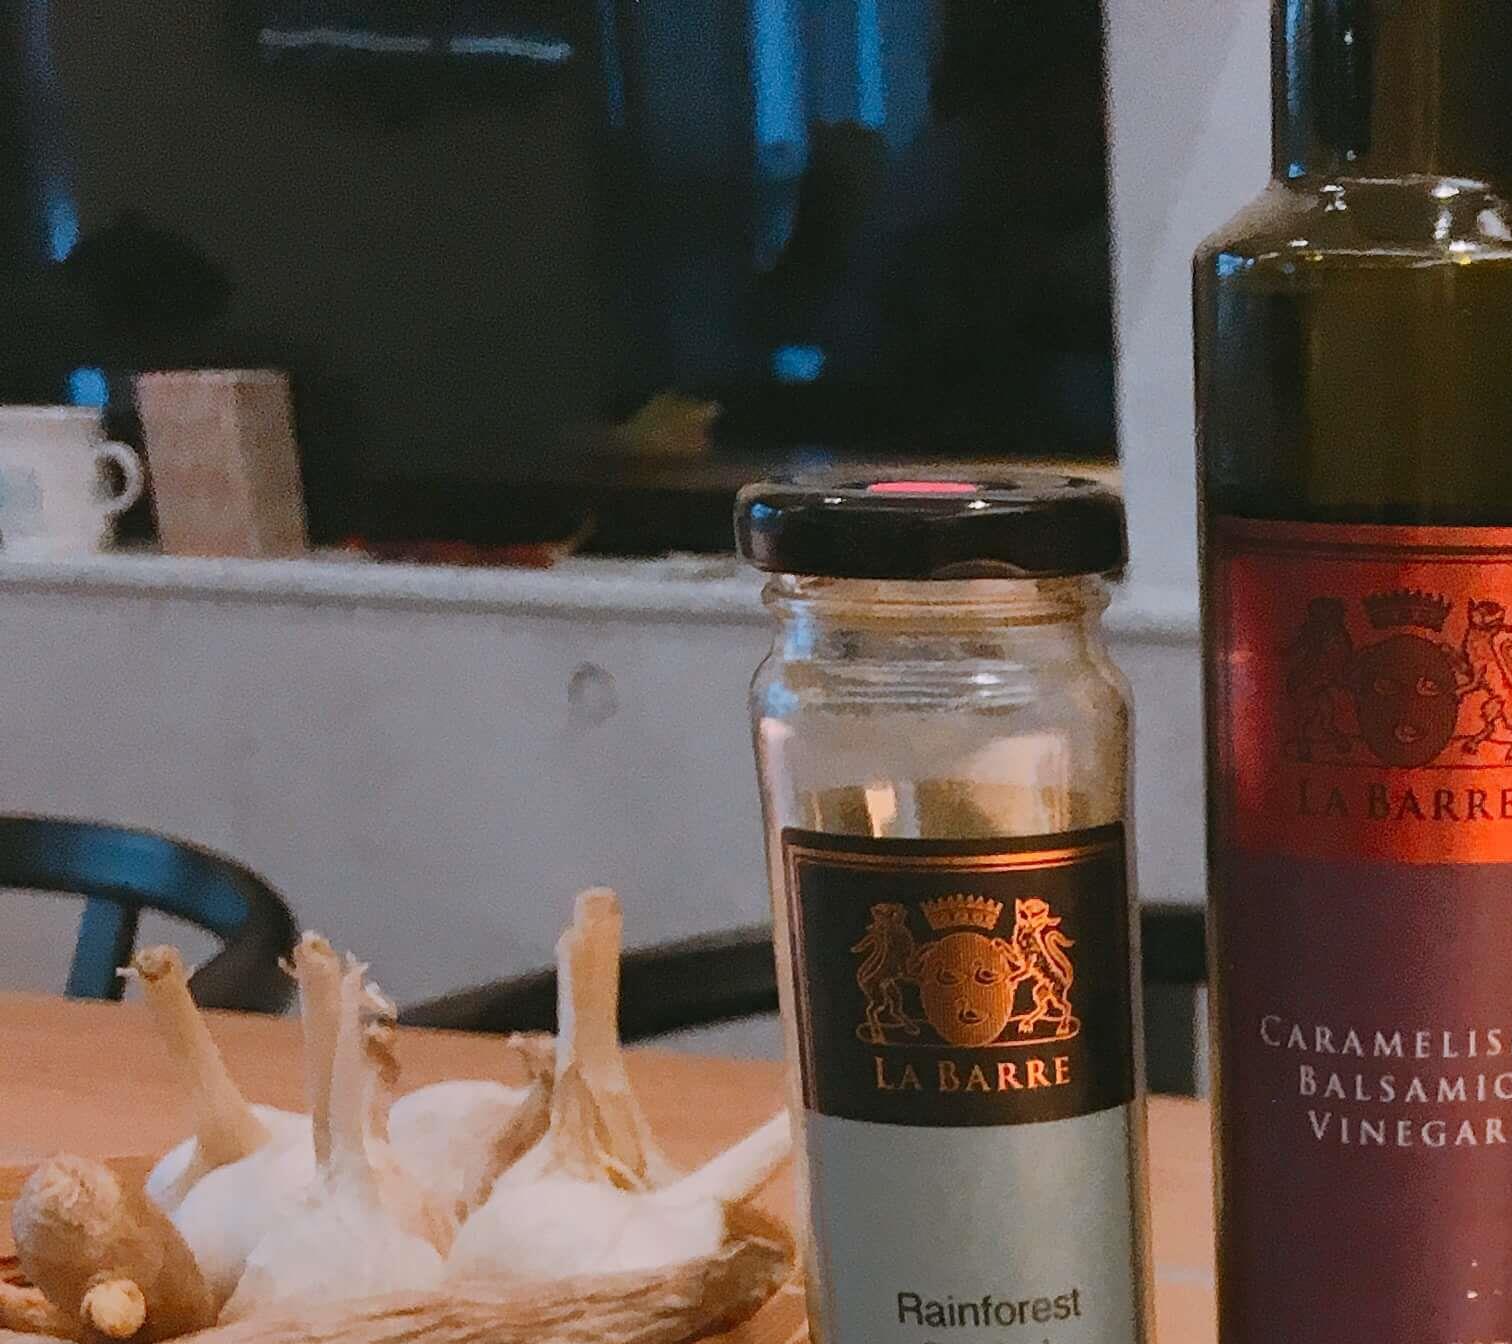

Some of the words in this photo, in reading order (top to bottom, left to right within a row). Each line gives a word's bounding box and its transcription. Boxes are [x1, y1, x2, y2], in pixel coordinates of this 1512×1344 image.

[874, 1055, 924, 1093] LA
[938, 1055, 1072, 1094] BARRE
[1308, 1110, 1507, 1148] VINEGAR
[897, 1287, 1082, 1330] Rainforest
